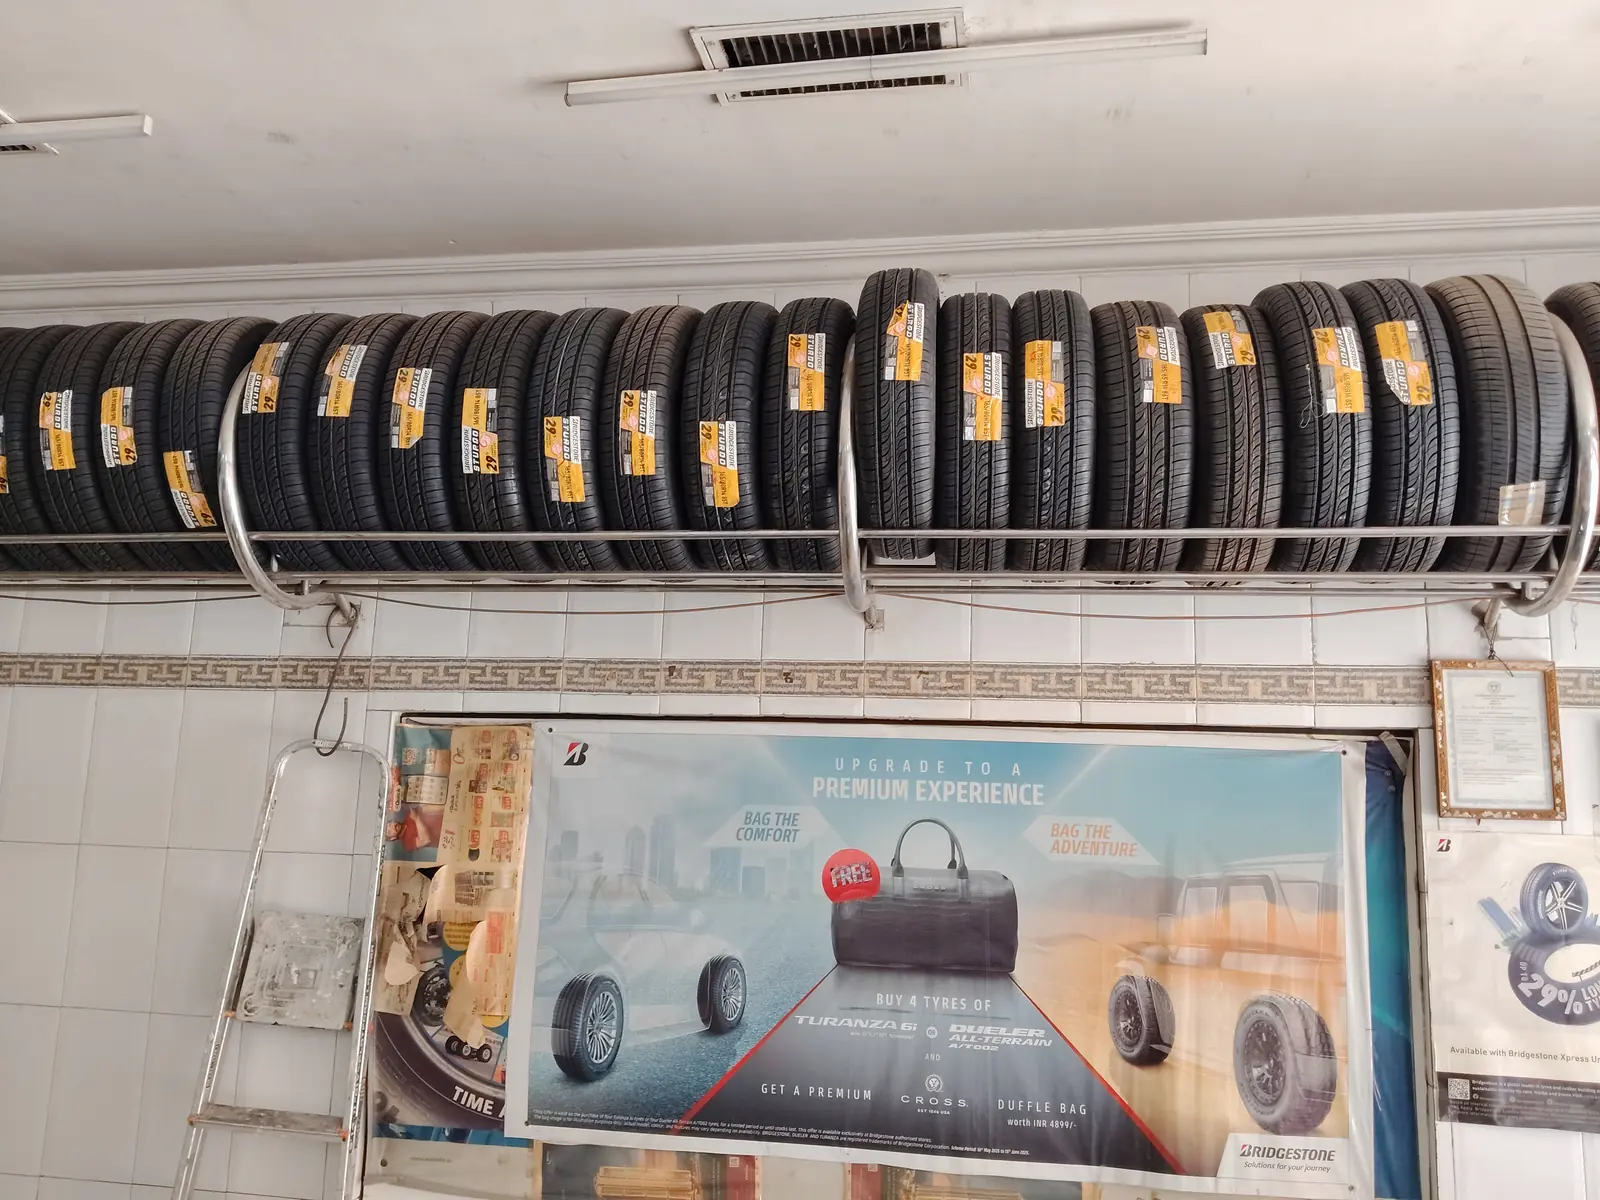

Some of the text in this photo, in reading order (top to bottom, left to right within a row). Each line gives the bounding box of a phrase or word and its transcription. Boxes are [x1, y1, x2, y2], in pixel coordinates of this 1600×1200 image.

[914, 305, 923, 341] BRIDGESTONE
[816, 335, 824, 370] BRIDGESTONE
[1157, 328, 1168, 360] STURDO
[1166, 328, 1178, 362] BRIDGESTONE
[1212, 334, 1226, 366] BRIDGESTONE
[1222, 334, 1235, 364] STURDO
[1335, 329, 1348, 366] STURDO
[1346, 329, 1359, 368] BRIDGESTONE
[340, 346, 356, 378] STURDO
[984, 354, 992, 394] STURDO
[252, 374, 262, 412] STURDO
[409, 370, 421, 406] STURDO
[418, 370, 430, 408] BRIDGESTONE
[1396, 362, 1410, 404] STURDO
[648, 392, 656, 434] BRIDGESTONE
[110, 426, 120, 464] STURDO
[572, 418, 580, 463] BRIDGESTONE
[727, 424, 735, 467] BRIDGESTONE
[836, 758, 1020, 776] UPGRADE TO A
[813, 776, 1044, 806] PREMIUM EXPERIENCE
[744, 811, 800, 827] BAG THE
[1051, 822, 1112, 839] BAG THE
[736, 827, 800, 843] COMFORT
[1050, 840, 1138, 857] ADVENTURE
[831, 862, 872, 888] FREE
[876, 993, 992, 1012] BUY 4 TYRES OF
[1518, 974, 1583, 1014] 29%
[794, 1016, 918, 1031] TURANZA 6i
[949, 1024, 1046, 1037] DUELER
[949, 1035, 1052, 1047] ALL-TERRAIN
[1450, 1047, 1487, 1056] Available
[1509, 1050, 1558, 1060] Bridgestone
[1560, 1053, 1589, 1062] Xpress
[925, 1053, 940, 1061] AND
[453, 1086, 494, 1116] TIME
[761, 1084, 872, 1100] GET A PREMIUM
[900, 1095, 967, 1108] CROSS
[998, 1099, 1087, 1115] DUFFLE BAG
[1007, 1117, 1076, 1130] worth INR 4899/-
[1240, 1144, 1336, 1162] BRIDGESTONE
[1244, 1161, 1275, 1170] Solutions
[1276, 1163, 1288, 1171] for
